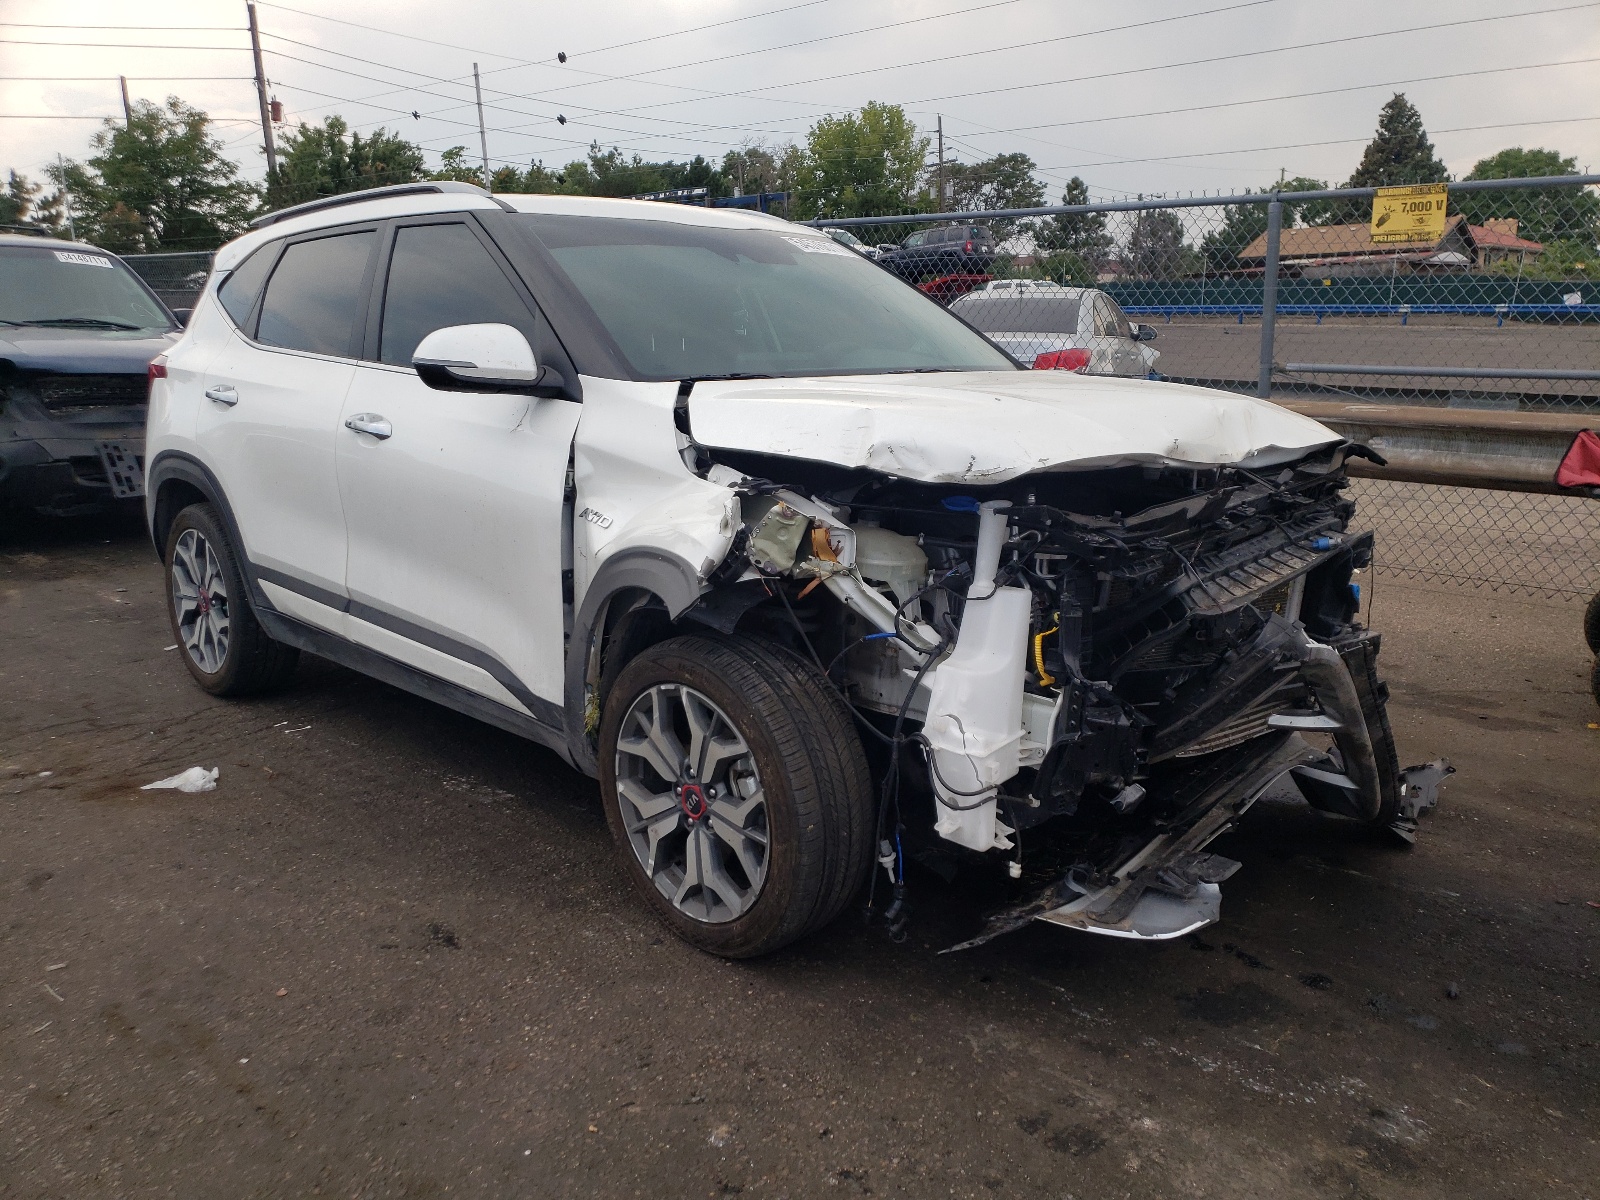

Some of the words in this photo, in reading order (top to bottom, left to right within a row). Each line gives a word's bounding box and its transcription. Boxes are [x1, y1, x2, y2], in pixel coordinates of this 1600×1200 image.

[1377, 187, 1412, 196] WARNING!
[1401, 200, 1432, 215] 7,000
[1436, 200, 1443, 210] V
[579, 507, 614, 529] AWD
[686, 794, 699, 810] KIA
